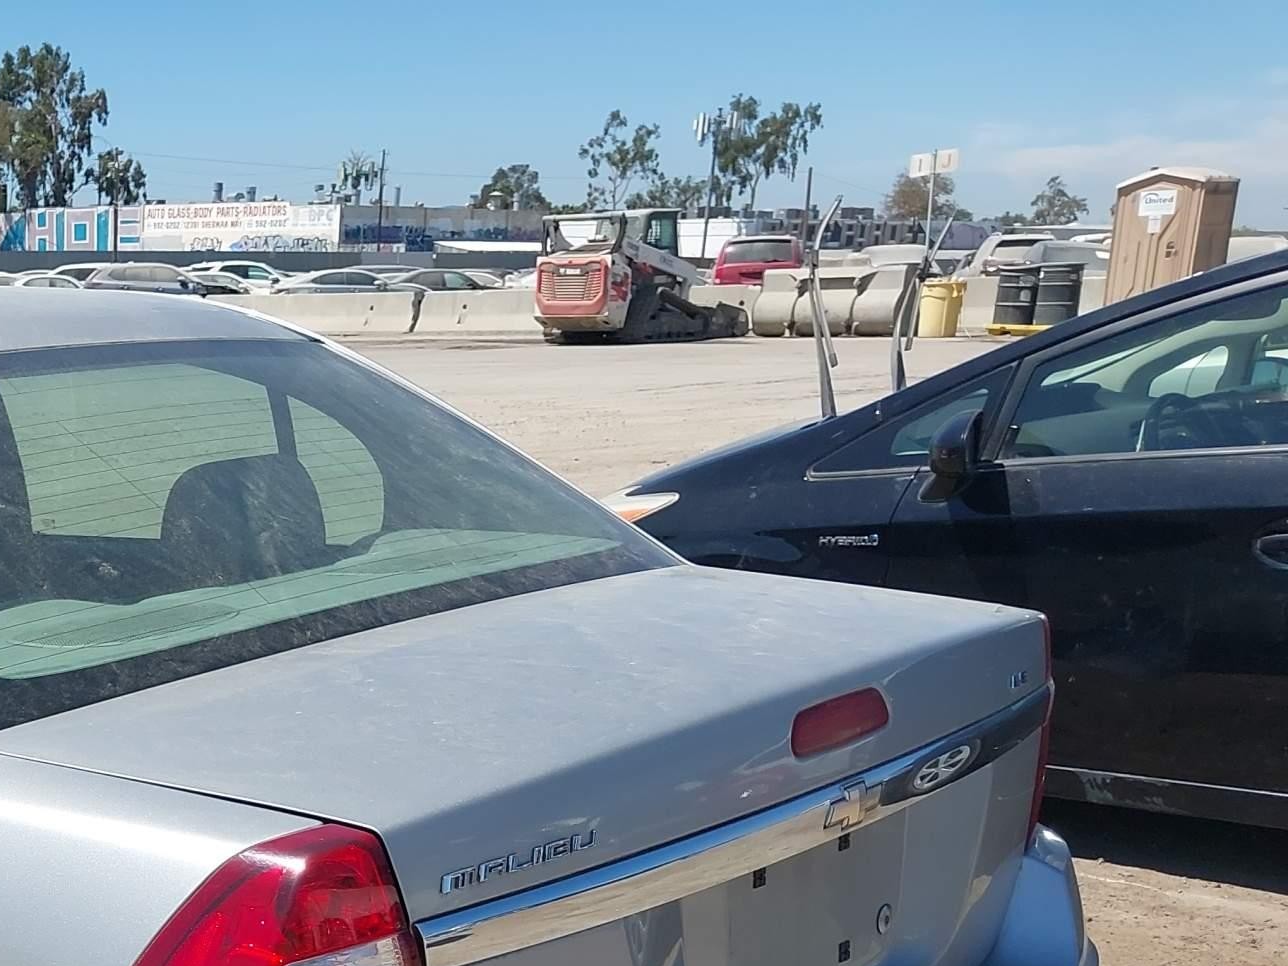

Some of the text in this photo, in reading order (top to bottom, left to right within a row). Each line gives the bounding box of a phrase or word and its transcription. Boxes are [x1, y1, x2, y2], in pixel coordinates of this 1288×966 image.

[941, 153, 952, 169] J
[1144, 195, 1174, 205] United
[147, 206, 165, 220] AUTO
[441, 828, 600, 895] MALIBU
